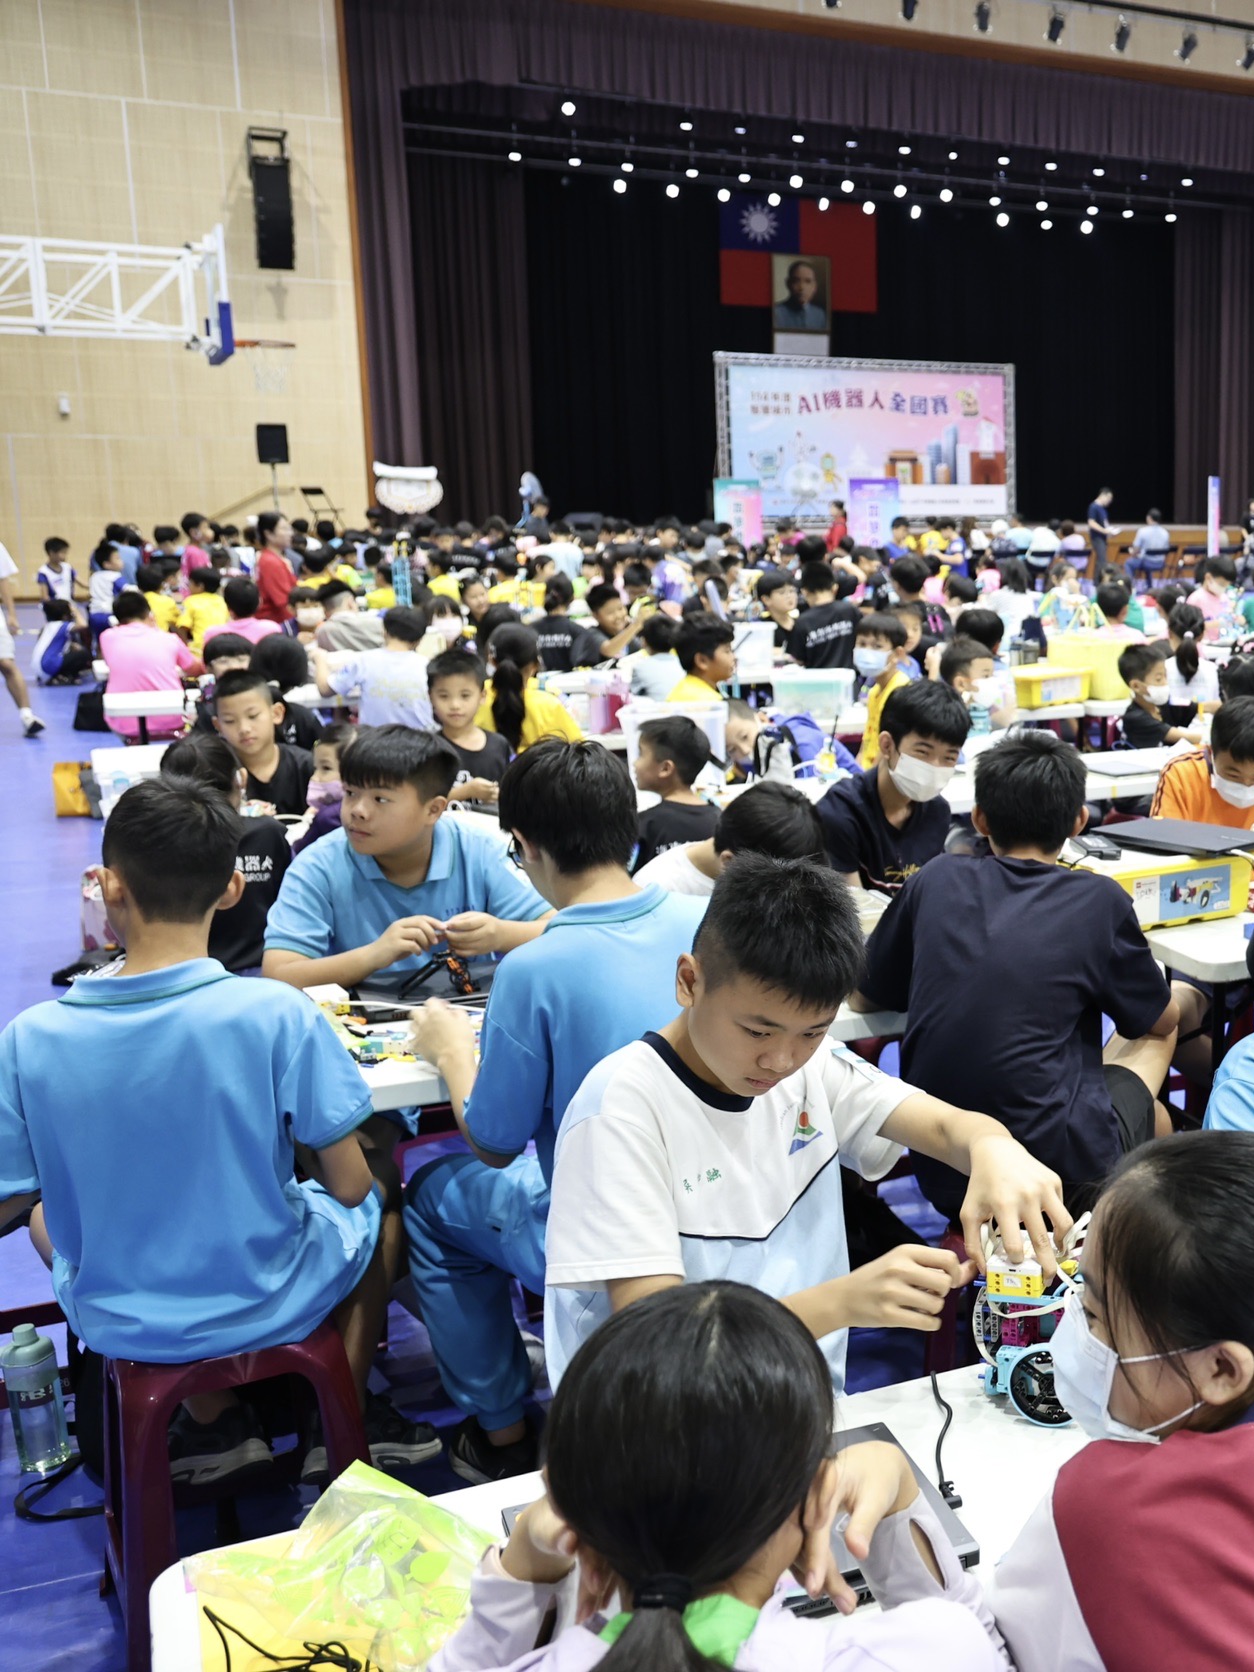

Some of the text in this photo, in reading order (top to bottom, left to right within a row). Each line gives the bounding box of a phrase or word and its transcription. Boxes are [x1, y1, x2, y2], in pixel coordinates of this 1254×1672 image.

[798, 388, 949, 416] AI機器人全國賽
